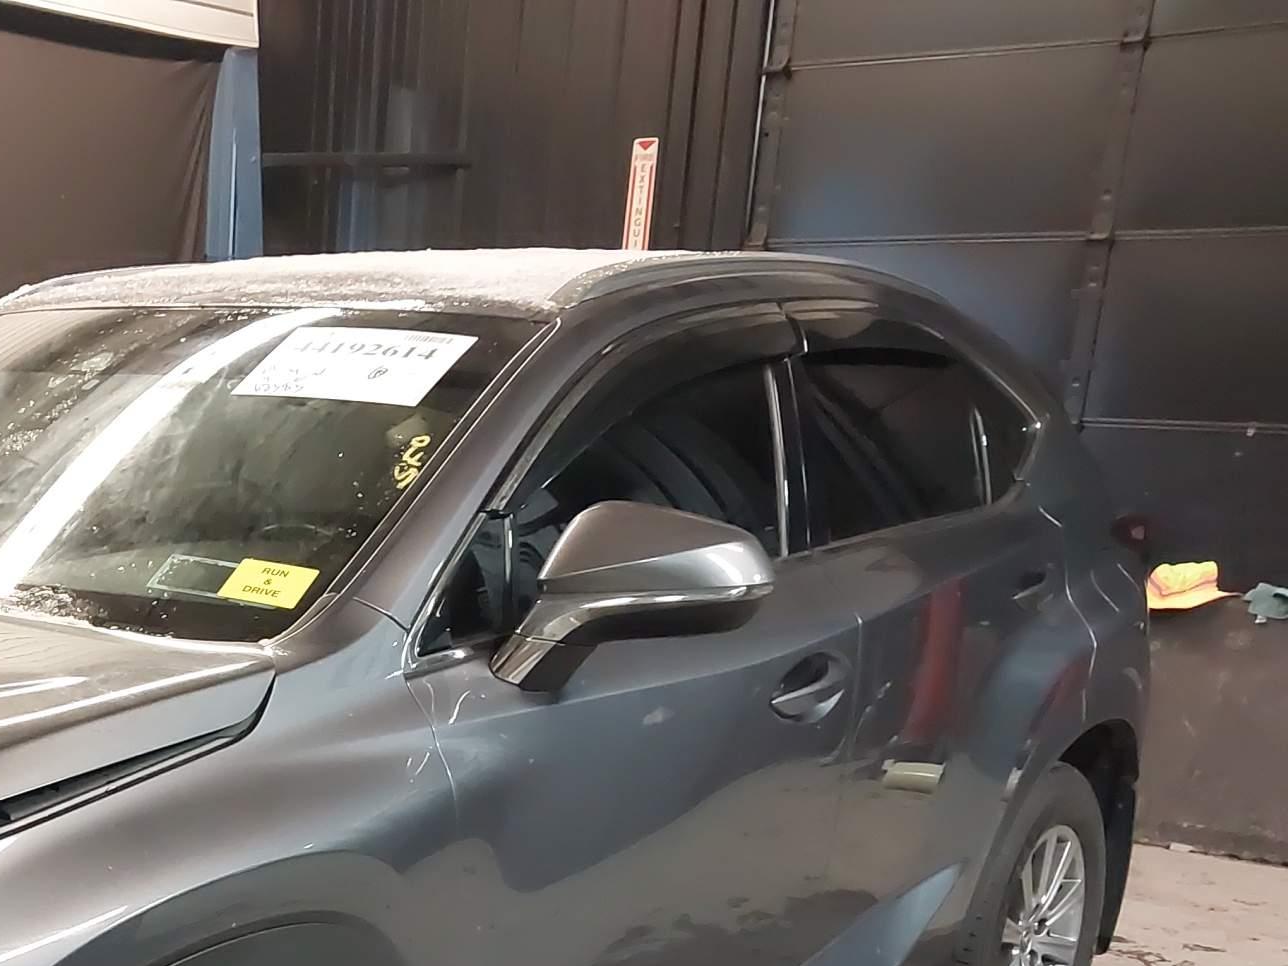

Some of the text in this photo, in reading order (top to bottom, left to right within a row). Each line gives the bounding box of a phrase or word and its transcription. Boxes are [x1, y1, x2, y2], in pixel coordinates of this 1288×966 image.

[261, 567, 290, 578] RUN
[263, 578, 272, 586] &
[241, 585, 281, 598] DRIVE
